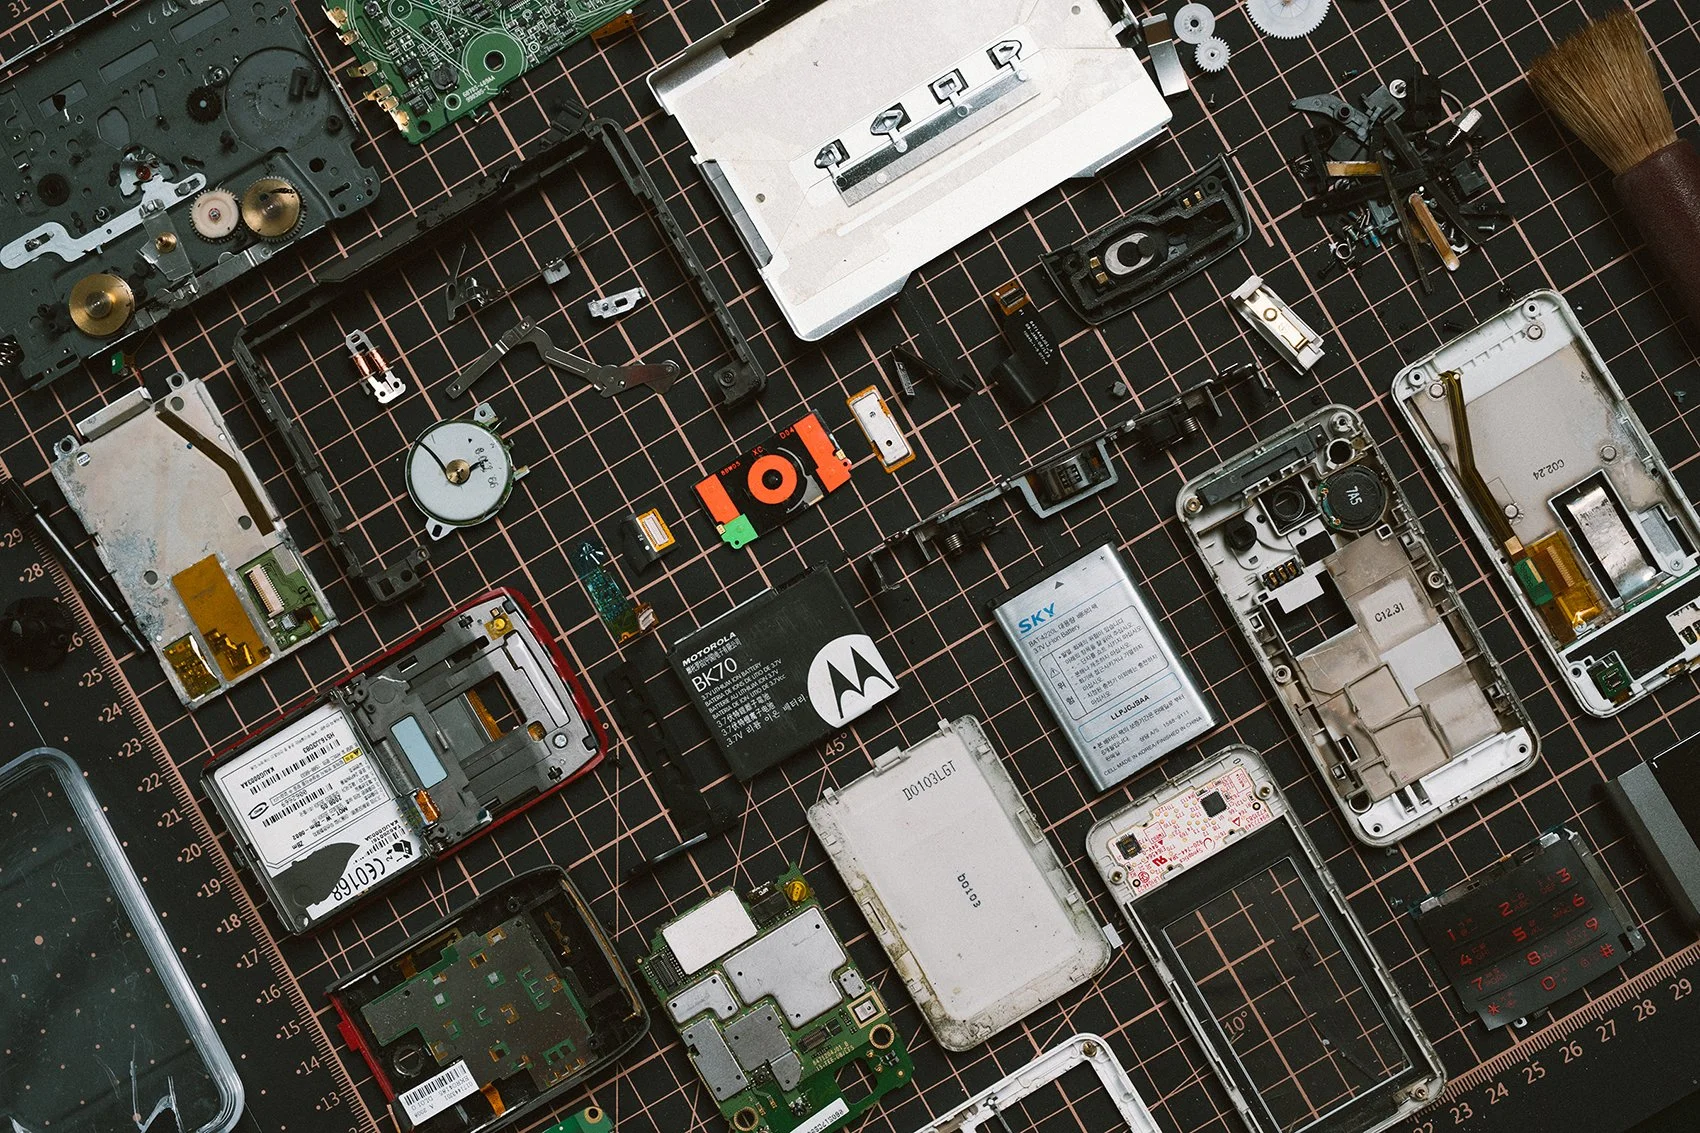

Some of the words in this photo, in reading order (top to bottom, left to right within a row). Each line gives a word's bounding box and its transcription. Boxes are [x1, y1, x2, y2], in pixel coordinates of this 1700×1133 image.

[8, 0, 30, 18] 31
[779, 426, 794, 439] D04
[1533, 459, 1564, 480] C02.24
[1346, 485, 1362, 505] 7A5
[4, 528, 23, 548] 29
[24, 563, 44, 583] 28
[1018, 603, 1054, 633] SKY
[1374, 602, 1404, 622] C12.31
[1060, 625, 1079, 638] Battery
[682, 632, 735, 666] MOTOROLA
[83, 667, 102, 688] 25
[692, 657, 737, 691] BK70
[711, 679, 732, 694] LITHIUM
[731, 673, 741, 682] ION
[740, 662, 761, 677] BATTERY
[730, 692, 738, 700] AU
[738, 681, 758, 695] LITHIUM
[757, 675, 768, 684] ION
[767, 668, 778, 678] 3.7V
[704, 692, 725, 706] BATERIA
[731, 700, 739, 708] DE
[764, 709, 780, 721] 이온
[782, 694, 806, 711] 배터리
[102, 702, 122, 723] 24
[122, 737, 142, 758] 23
[1103, 766, 1117, 776] CELL
[1116, 757, 1131, 768] MADE
[1185, 716, 1202, 727] CHINA
[142, 772, 162, 792] 22
[902, 760, 957, 801] D0103LGT
[162, 808, 182, 828] 21
[182, 843, 202, 863] 20
[1557, 868, 1571, 883] 3
[202, 878, 221, 898] 19
[1499, 902, 1513, 917] 2
[1569, 891, 1586, 909] 6
[221, 913, 242, 933] 18
[1584, 917, 1598, 931] 9
[1512, 927, 1527, 942] 5
[241, 948, 258, 968] 17
[1456, 951, 1473, 968] 4
[1526, 951, 1540, 966] 8
[1470, 975, 1487, 992] 7
[1540, 976, 1556, 990] 0
[1670, 977, 1692, 1000] 29
[261, 984, 281, 1004] 16
[1632, 1000, 1656, 1022] 28
[281, 1020, 300, 1040] 15
[1596, 1020, 1616, 1042] 27
[1559, 1040, 1582, 1064] 26
[301, 1056, 320, 1076] 14
[1522, 1061, 1546, 1084] 25
[321, 1091, 340, 1111] 13
[1485, 1082, 1508, 1104] 24
[1450, 1102, 1473, 1124] 23
